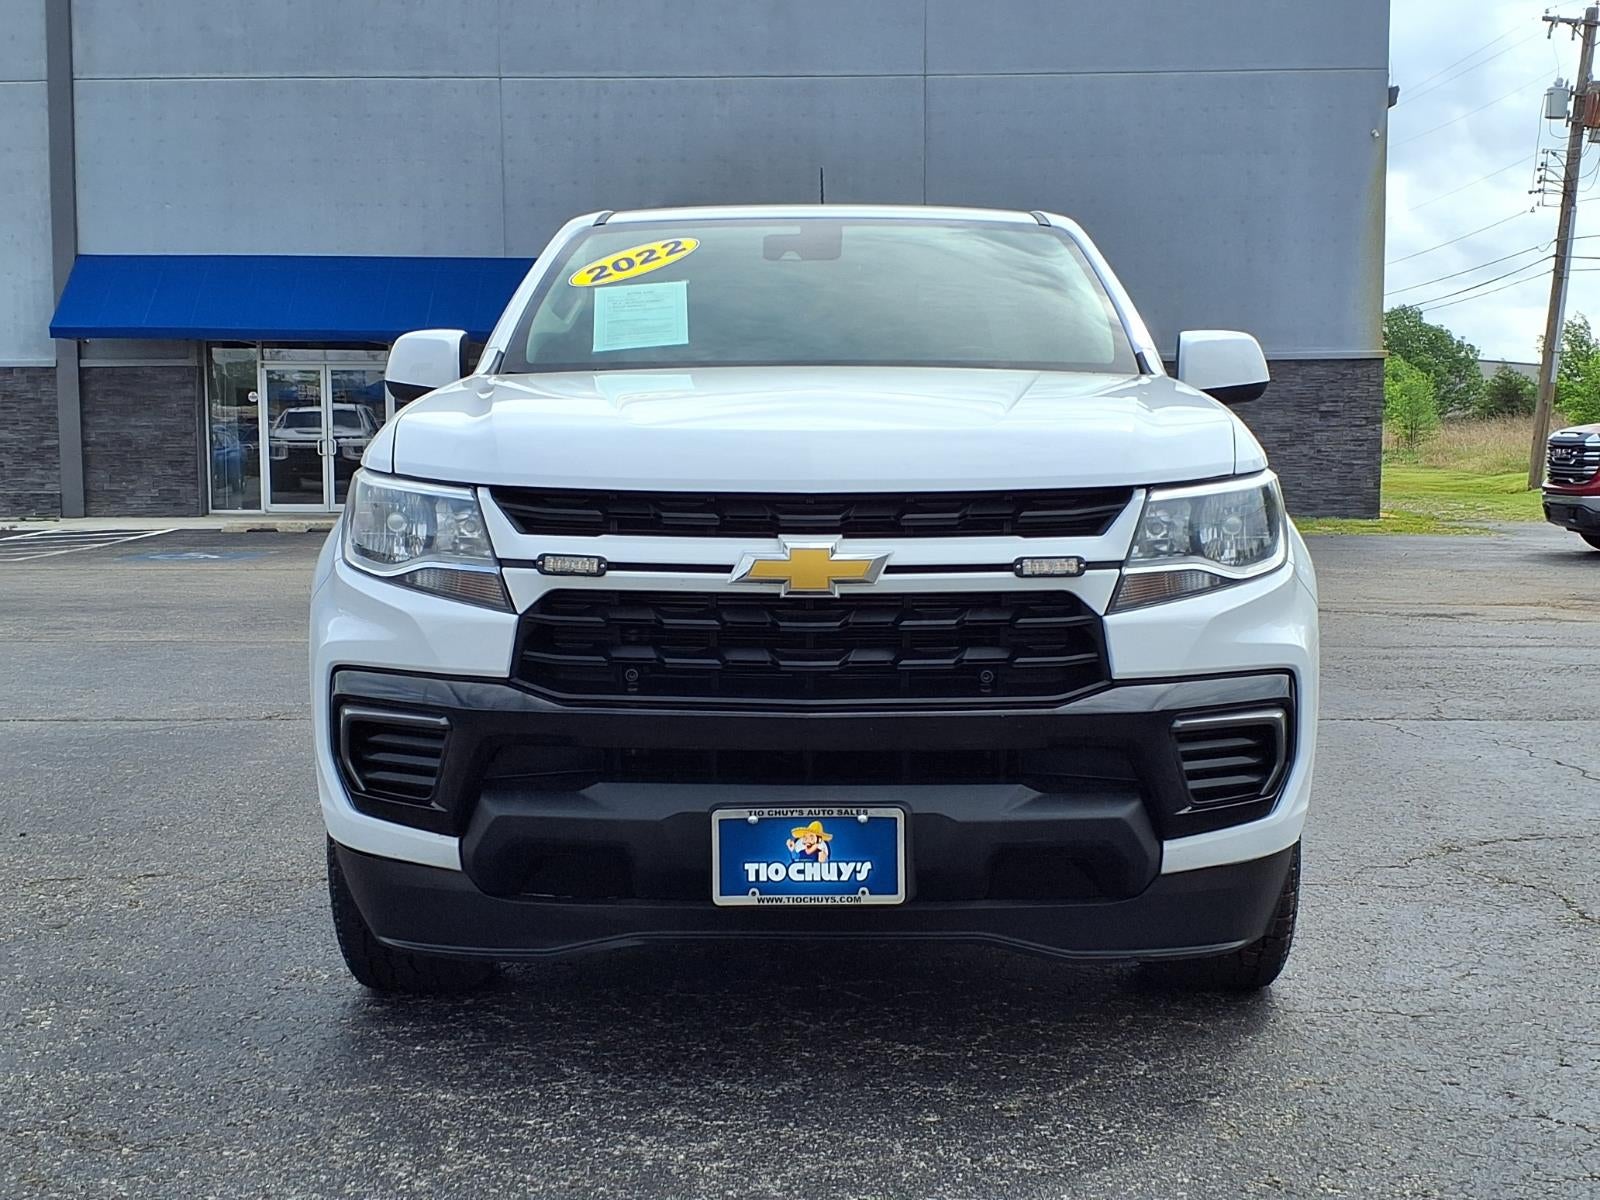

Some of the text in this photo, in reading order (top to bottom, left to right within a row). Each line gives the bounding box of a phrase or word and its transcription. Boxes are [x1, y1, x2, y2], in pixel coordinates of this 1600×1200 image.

[586, 240, 687, 282] 2022
[837, 808, 868, 816] SALES
[744, 861, 872, 882] TIO CHUY'S
[757, 896, 862, 904] WWW.TIOCHUYS.COM
